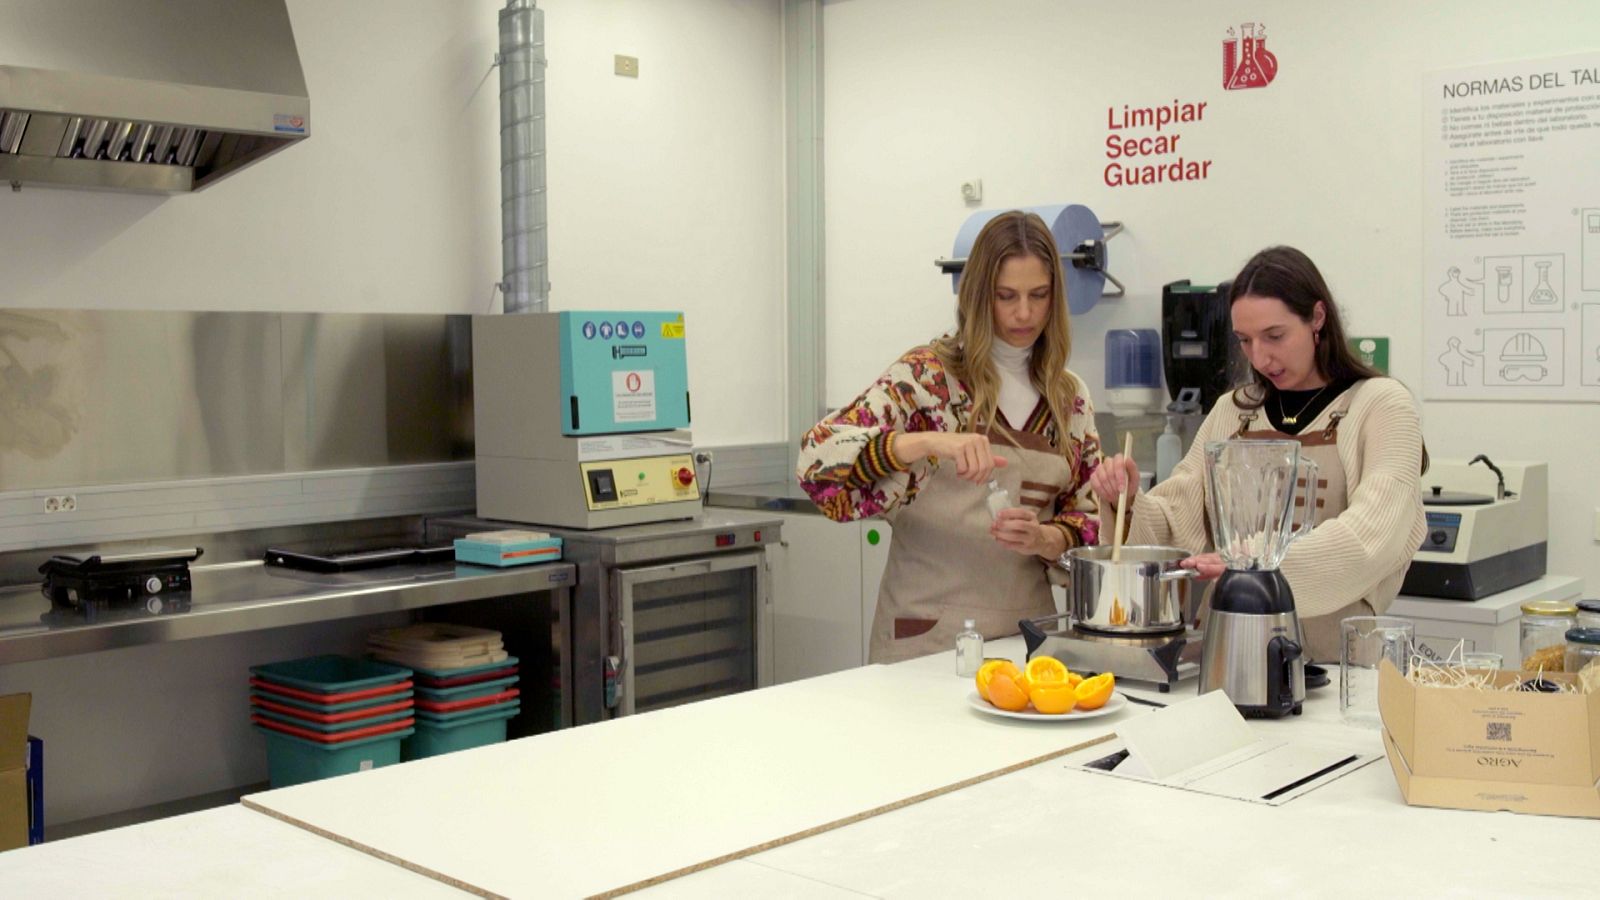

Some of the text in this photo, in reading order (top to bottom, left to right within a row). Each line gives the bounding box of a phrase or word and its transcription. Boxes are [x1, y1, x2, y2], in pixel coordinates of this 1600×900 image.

[1443, 75, 1523, 99] NORMAS
[1529, 72, 1565, 90] DEL
[1108, 99, 1207, 131] Limpiar
[1106, 134, 1180, 159] Secar
[1104, 157, 1212, 187] Guardar
[1477, 757, 1522, 768] AGRO
